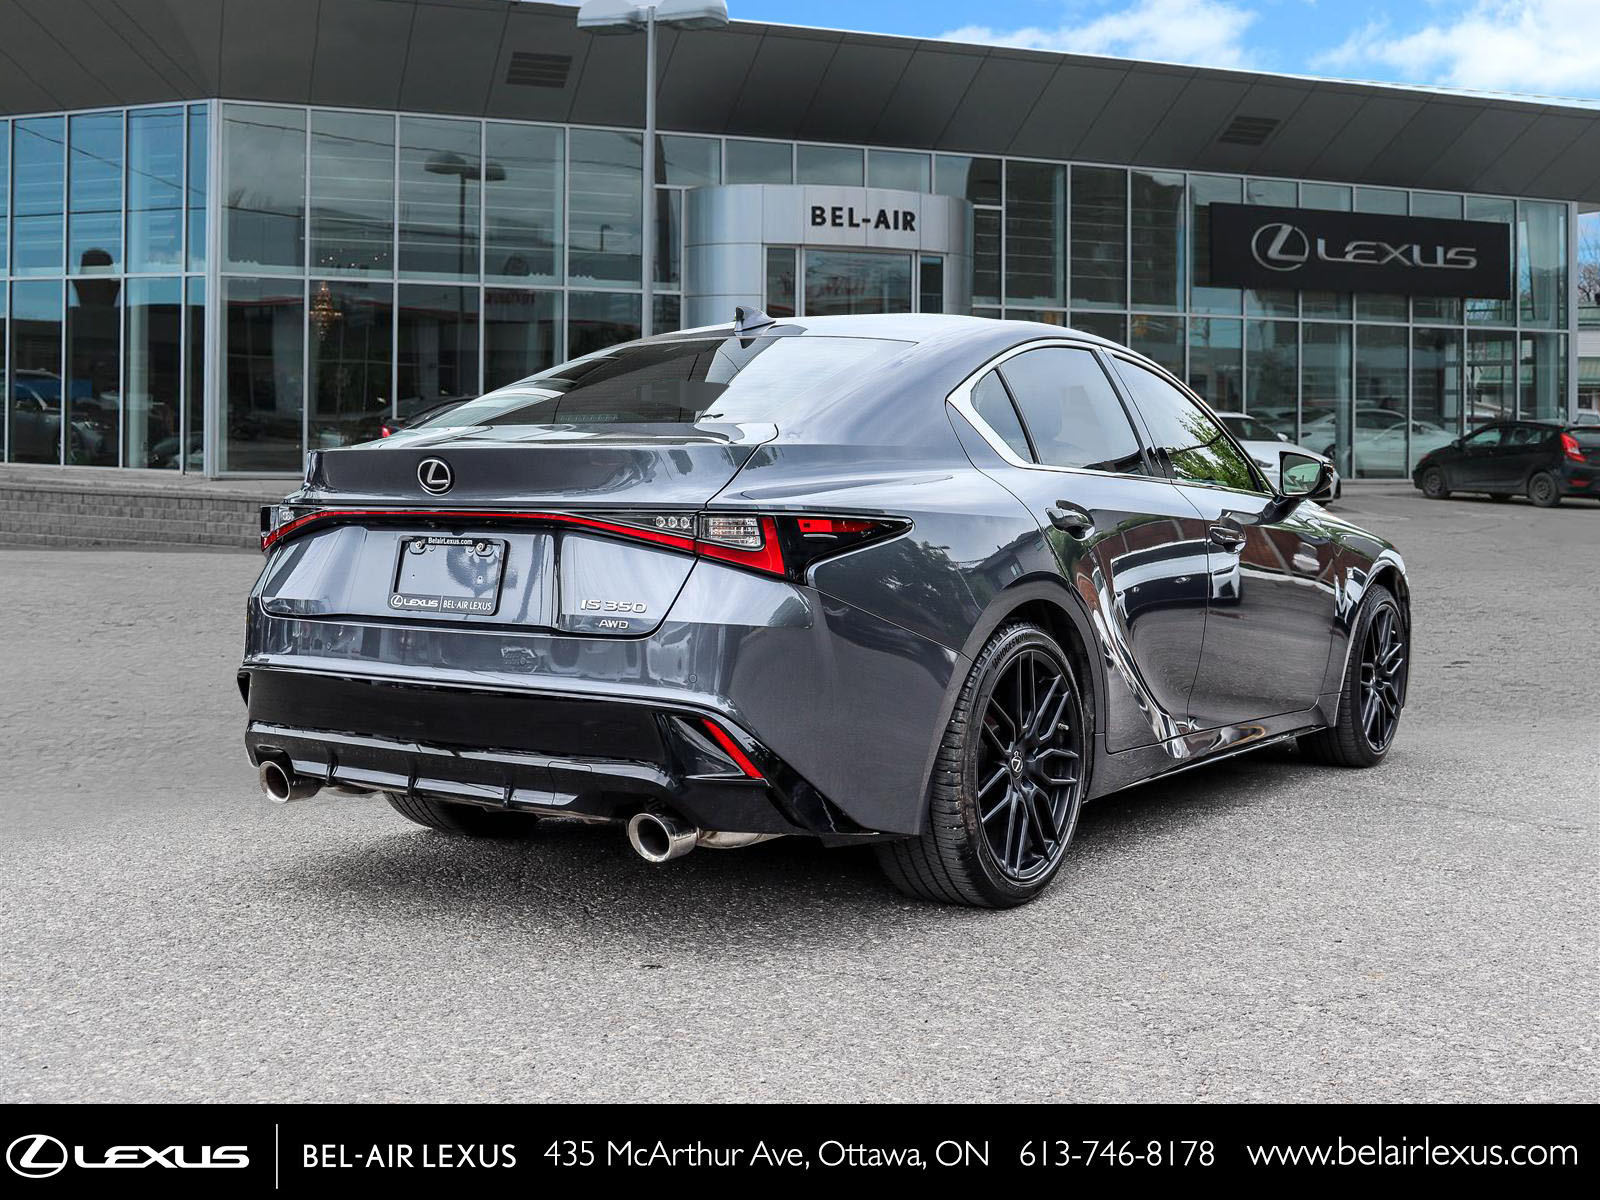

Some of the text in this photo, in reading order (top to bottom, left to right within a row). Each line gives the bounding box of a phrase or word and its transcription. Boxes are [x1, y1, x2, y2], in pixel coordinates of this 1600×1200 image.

[811, 205, 916, 232] BEL-AIR
[1317, 237, 1478, 269] LEXUS
[428, 537, 473, 545] BelairLexus.com
[403, 598, 439, 607] LEXUS
[443, 599, 492, 610] BEL-AIR LEXUS
[580, 599, 648, 614] IS 350
[598, 619, 629, 630] AWD
